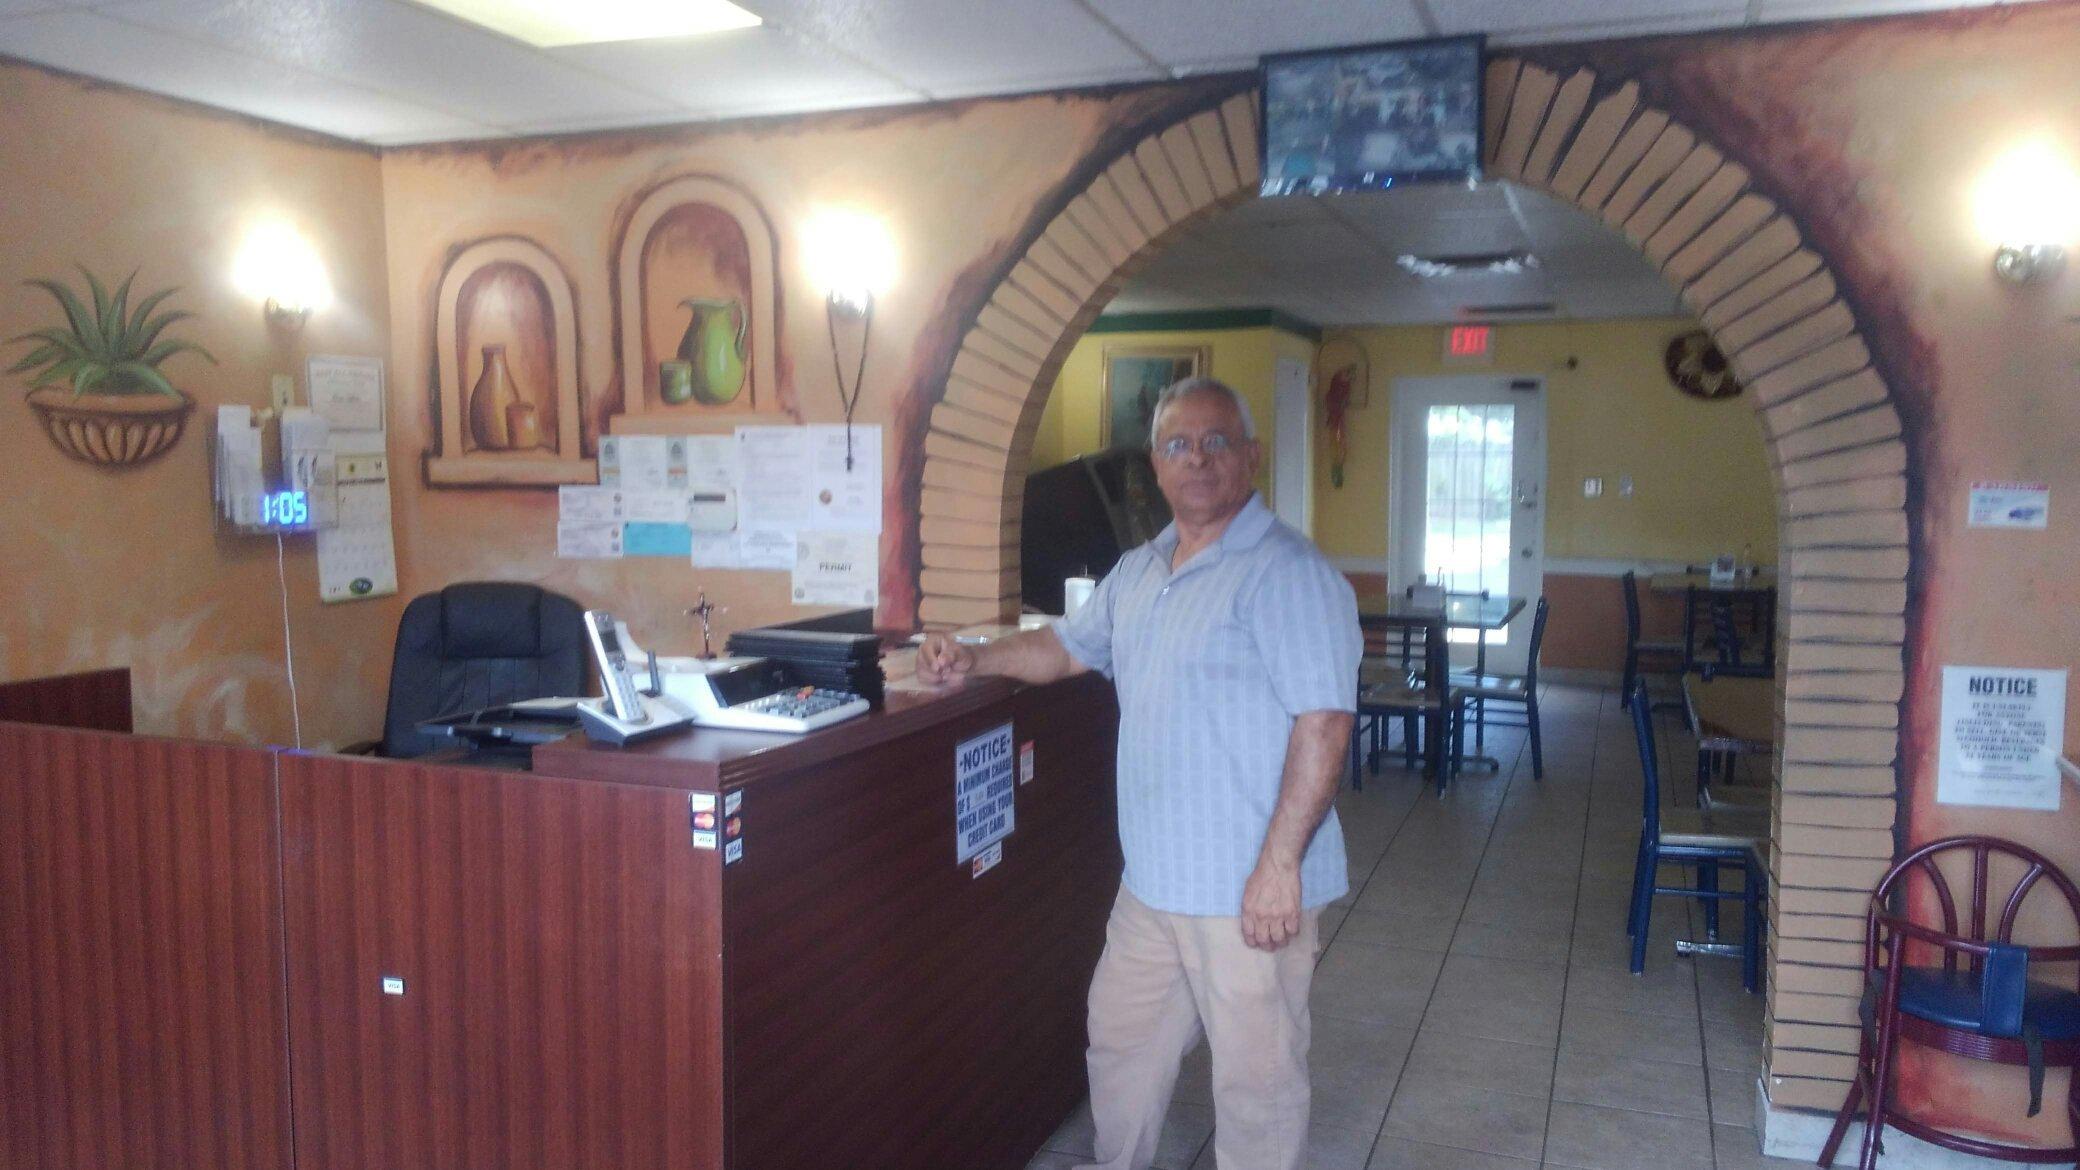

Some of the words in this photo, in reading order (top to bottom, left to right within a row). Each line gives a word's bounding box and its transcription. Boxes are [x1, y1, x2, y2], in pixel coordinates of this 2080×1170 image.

[1451, 326, 1489, 356] EXIT
[264, 491, 308, 524] 1:05
[1968, 675, 2038, 698] NOTICE
[958, 811, 977, 834] WHEN
[968, 823, 988, 848] CREDIT
[989, 812, 1005, 835] CARD
